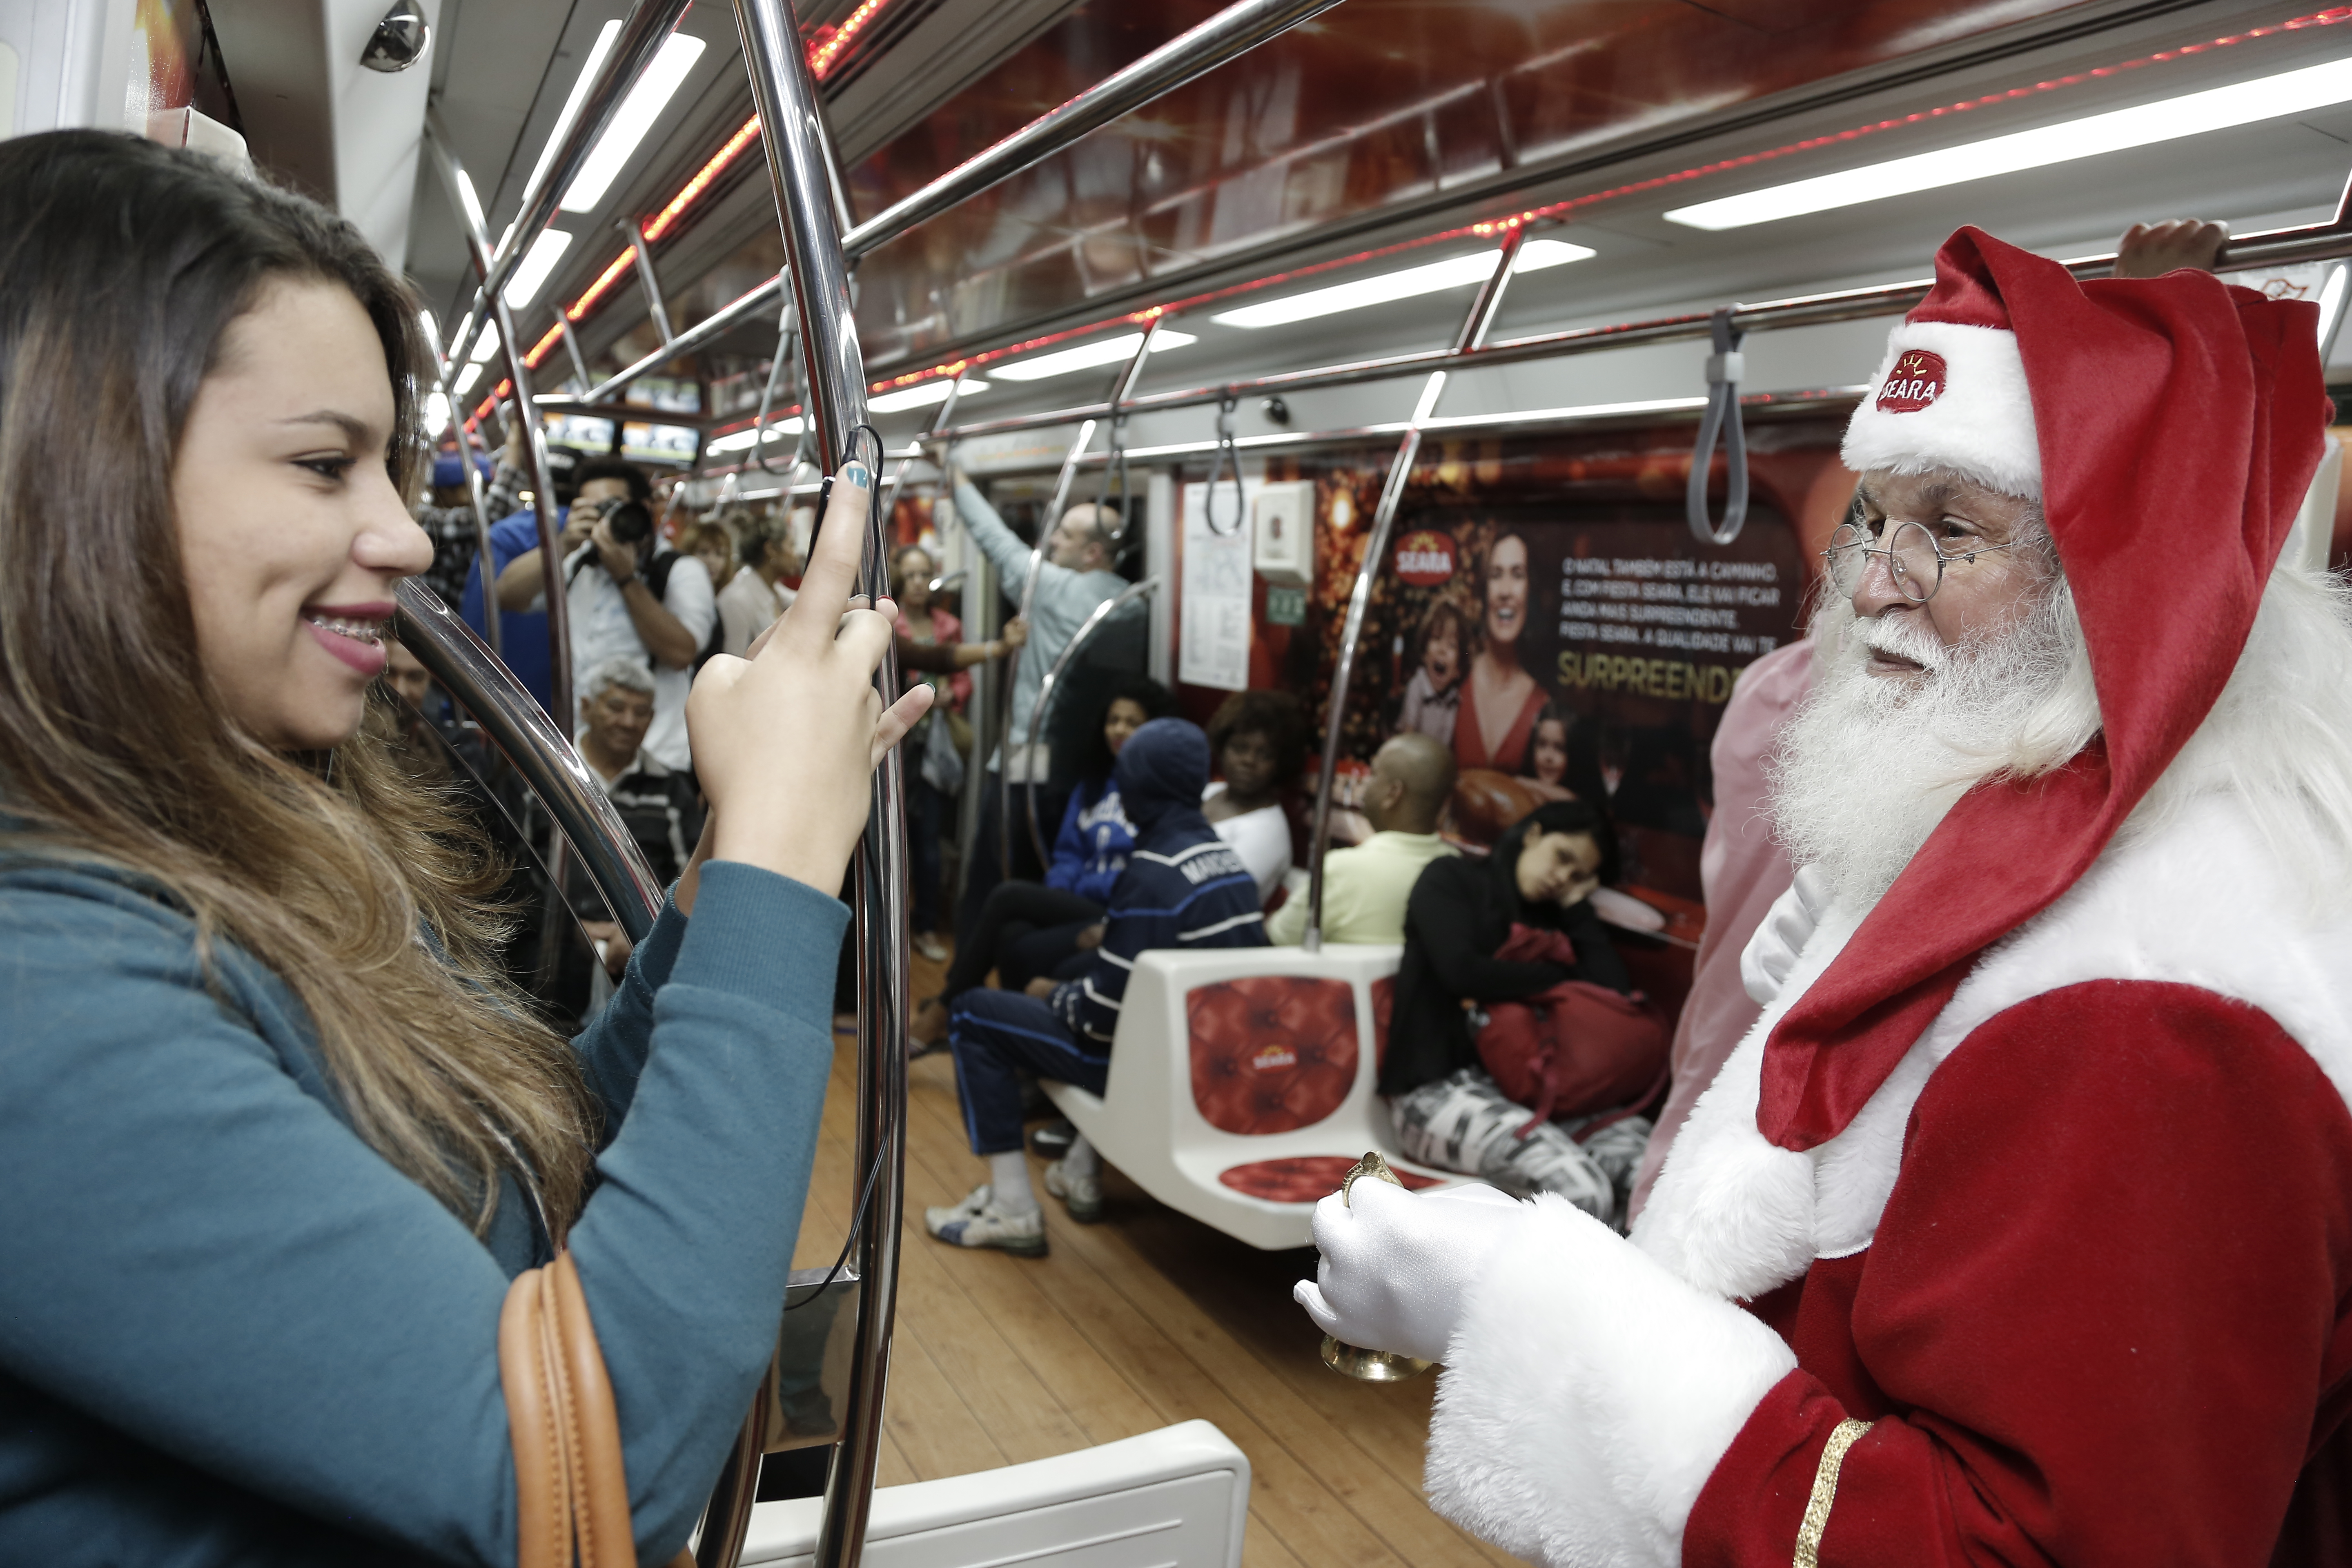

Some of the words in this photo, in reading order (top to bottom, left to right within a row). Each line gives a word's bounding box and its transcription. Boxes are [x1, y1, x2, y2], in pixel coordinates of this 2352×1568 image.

[1879, 378, 1937, 401] SEARA
[1396, 551, 1452, 574] SEARA
[1562, 557, 1574, 575] O
[1575, 558, 1611, 576] NATAL
[1612, 556, 1662, 578] TAMBÉM
[1697, 561, 1708, 579] A
[1685, 584, 1712, 604] ELE
[1737, 586, 1781, 607] FICAR
[1560, 600, 1597, 619] AINDA
[1597, 602, 1628, 621] MAIS
[1642, 627, 1654, 642] A
[1655, 628, 1731, 653] QUALIDADE
